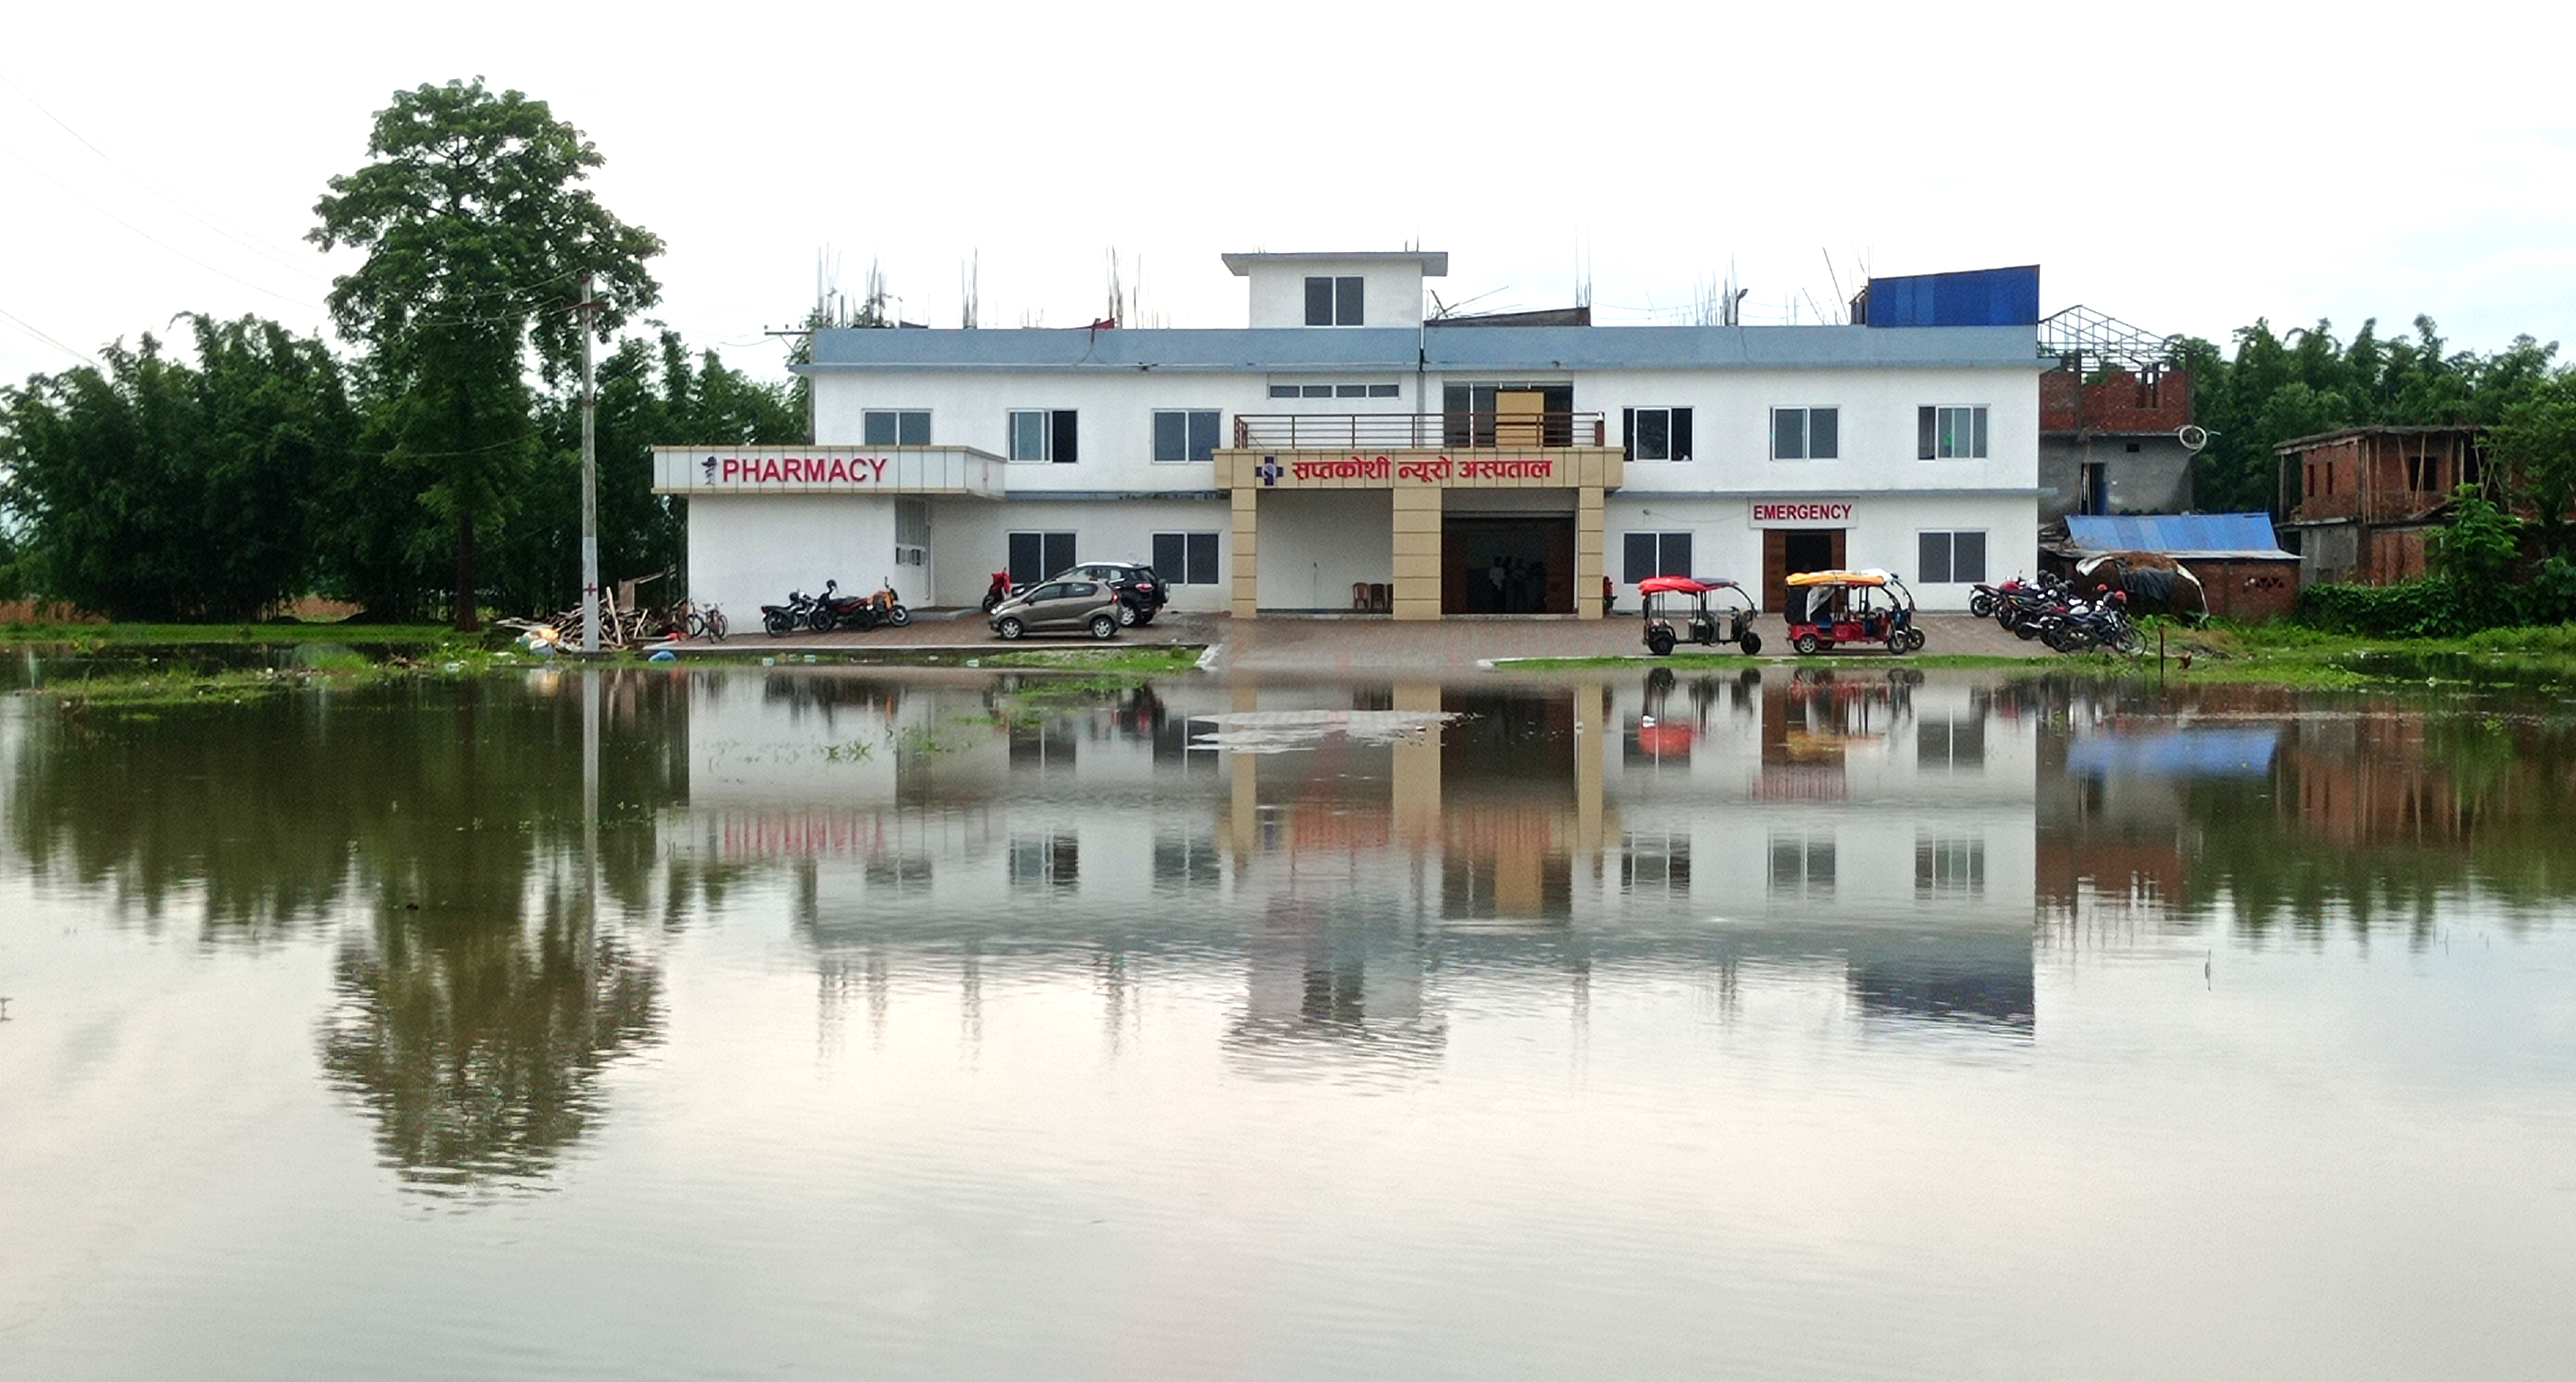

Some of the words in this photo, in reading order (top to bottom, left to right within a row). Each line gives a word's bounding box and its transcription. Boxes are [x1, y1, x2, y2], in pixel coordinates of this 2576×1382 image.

[722, 457, 887, 482] PHARMACY
[1292, 456, 1390, 480] सप्तकोशी
[1397, 456, 1452, 482] न्यूरो
[1458, 458, 1553, 479] अस्पताल
[1754, 504, 1853, 520] EMERGENCY
